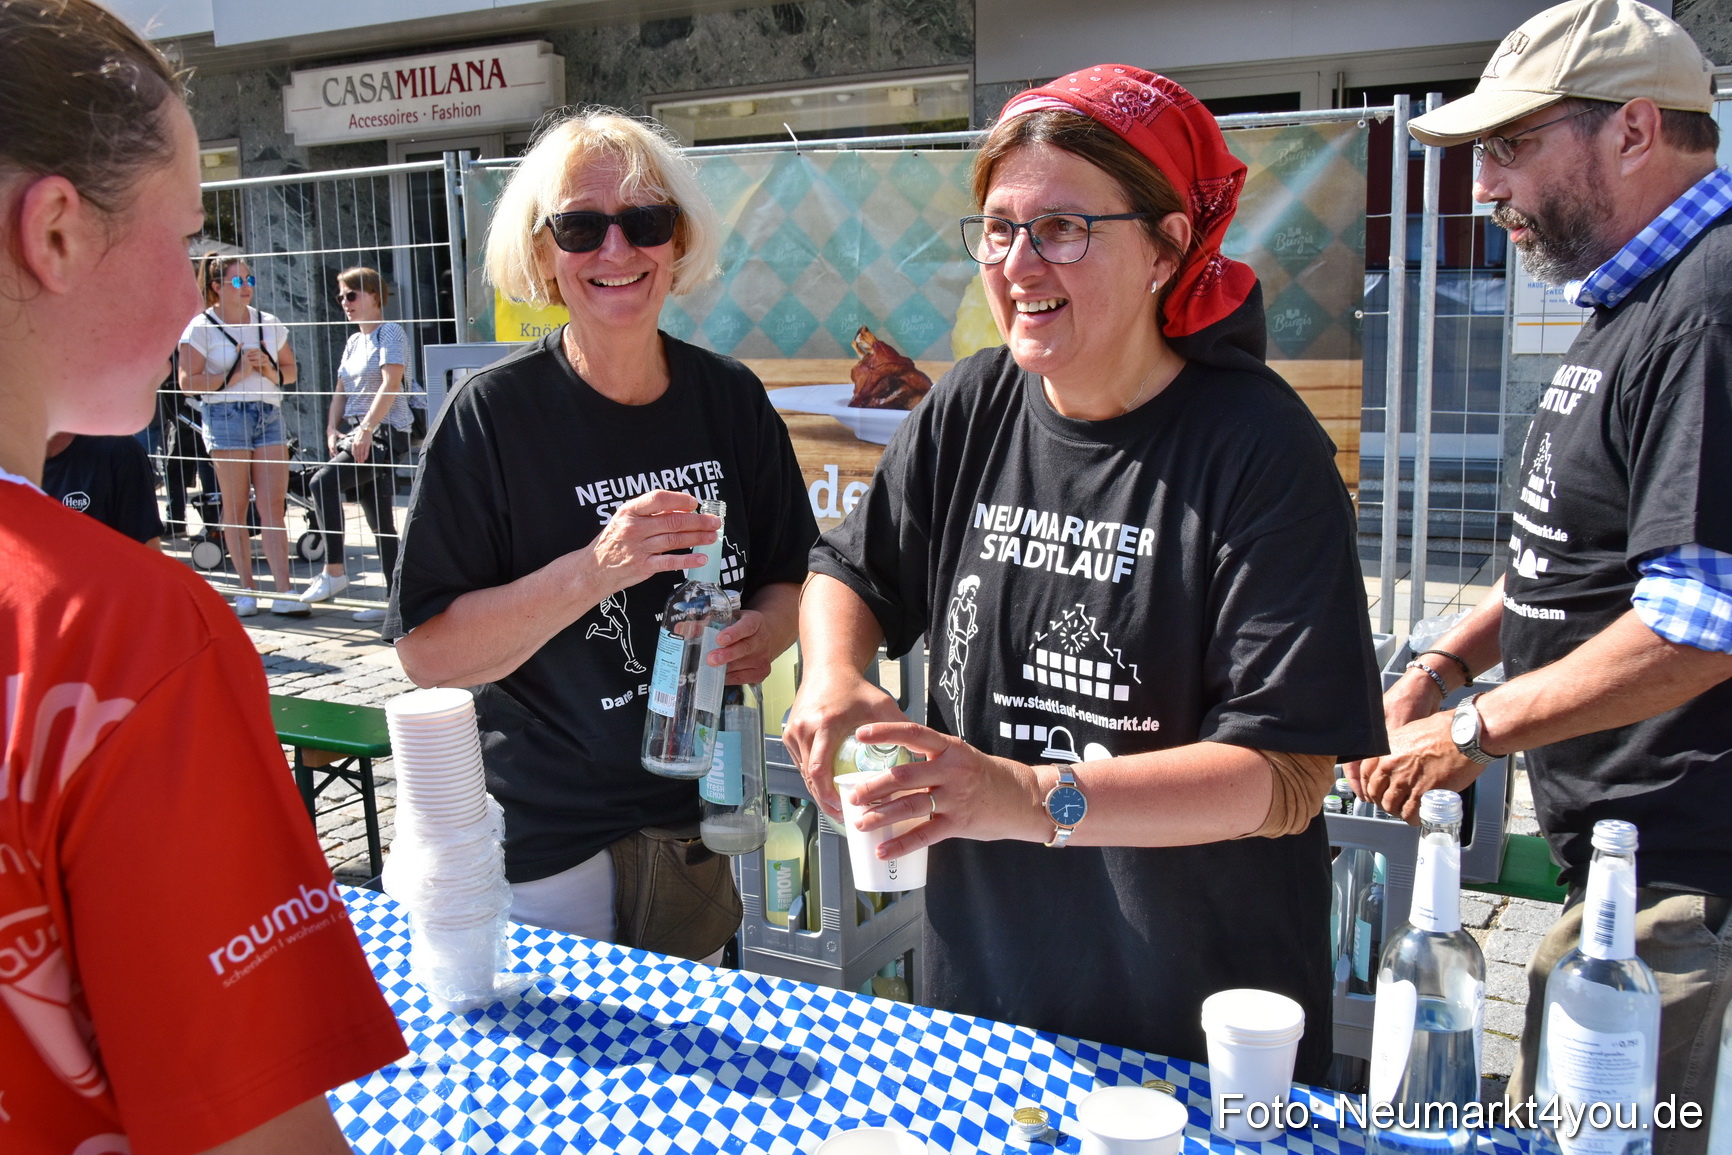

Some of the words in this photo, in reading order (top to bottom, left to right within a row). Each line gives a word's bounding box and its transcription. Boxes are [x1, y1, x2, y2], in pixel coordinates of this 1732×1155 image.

[321, 57, 508, 107] CASAMILANA
[348, 110, 419, 130] Accessoires
[431, 102, 482, 121] Fashion
[574, 460, 725, 506] NEUMARKTER
[973, 502, 1156, 556] NEUMARKTER
[980, 533, 1135, 583] STADTLAUF
[993, 691, 1160, 732] www.stadtlauf-neumarkt.de
